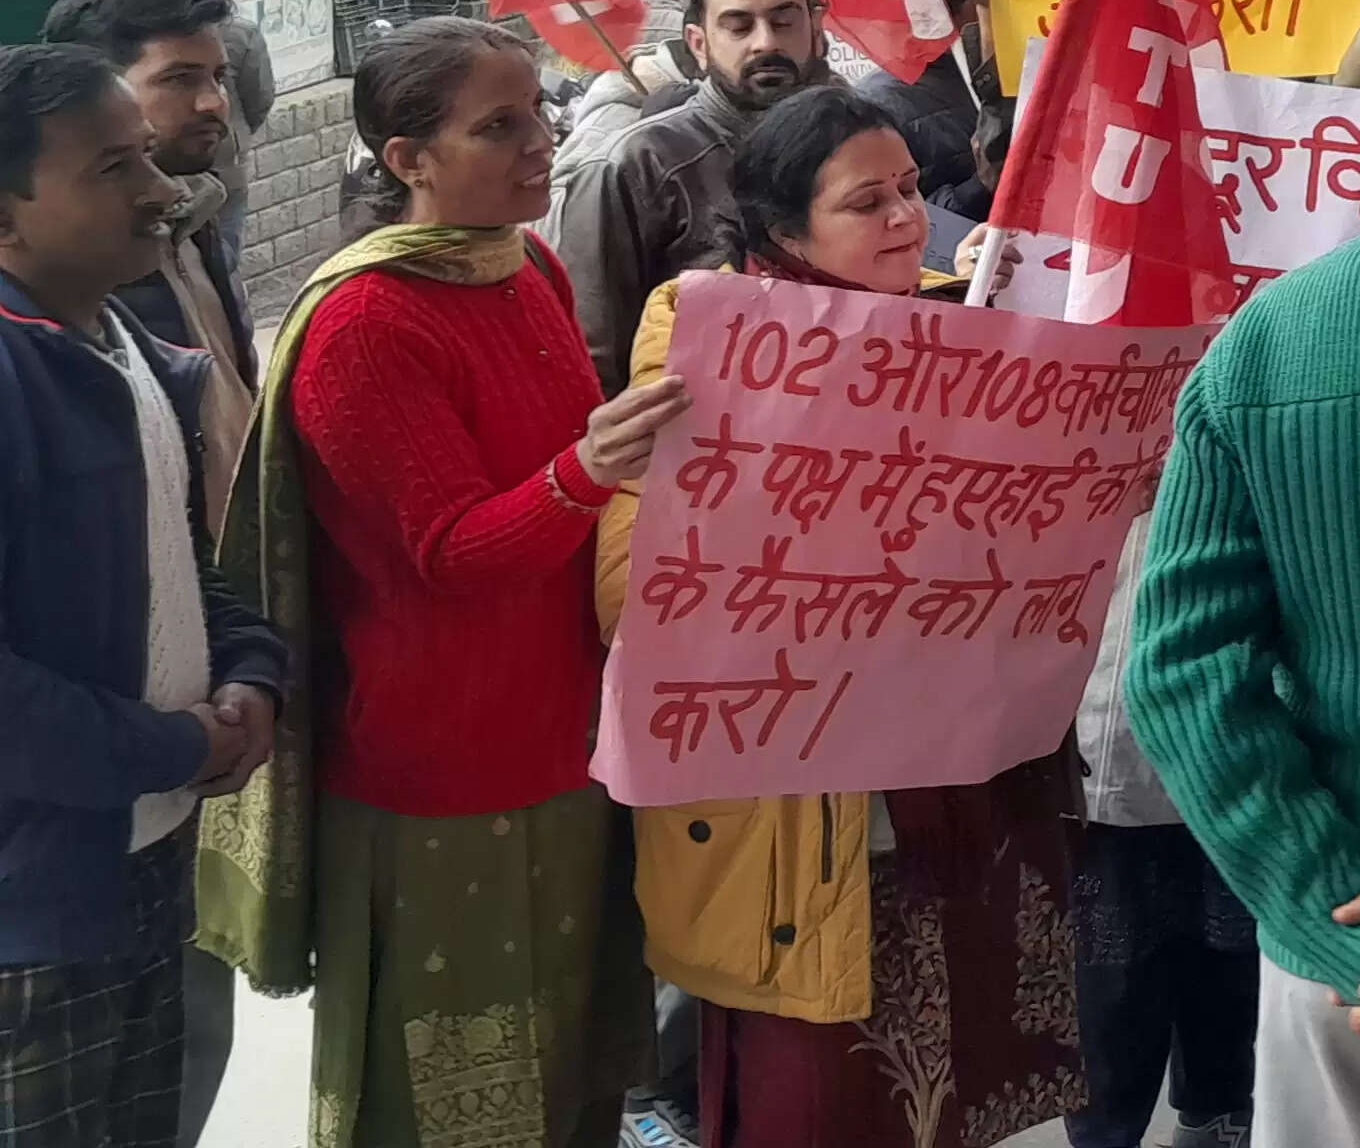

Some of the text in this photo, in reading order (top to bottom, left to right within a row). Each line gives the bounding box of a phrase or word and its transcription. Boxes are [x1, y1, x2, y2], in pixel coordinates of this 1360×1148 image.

[718, 313, 840, 398] 102
[676, 412, 766, 512] के
[641, 525, 726, 627] के
[907, 547, 1014, 641] को
